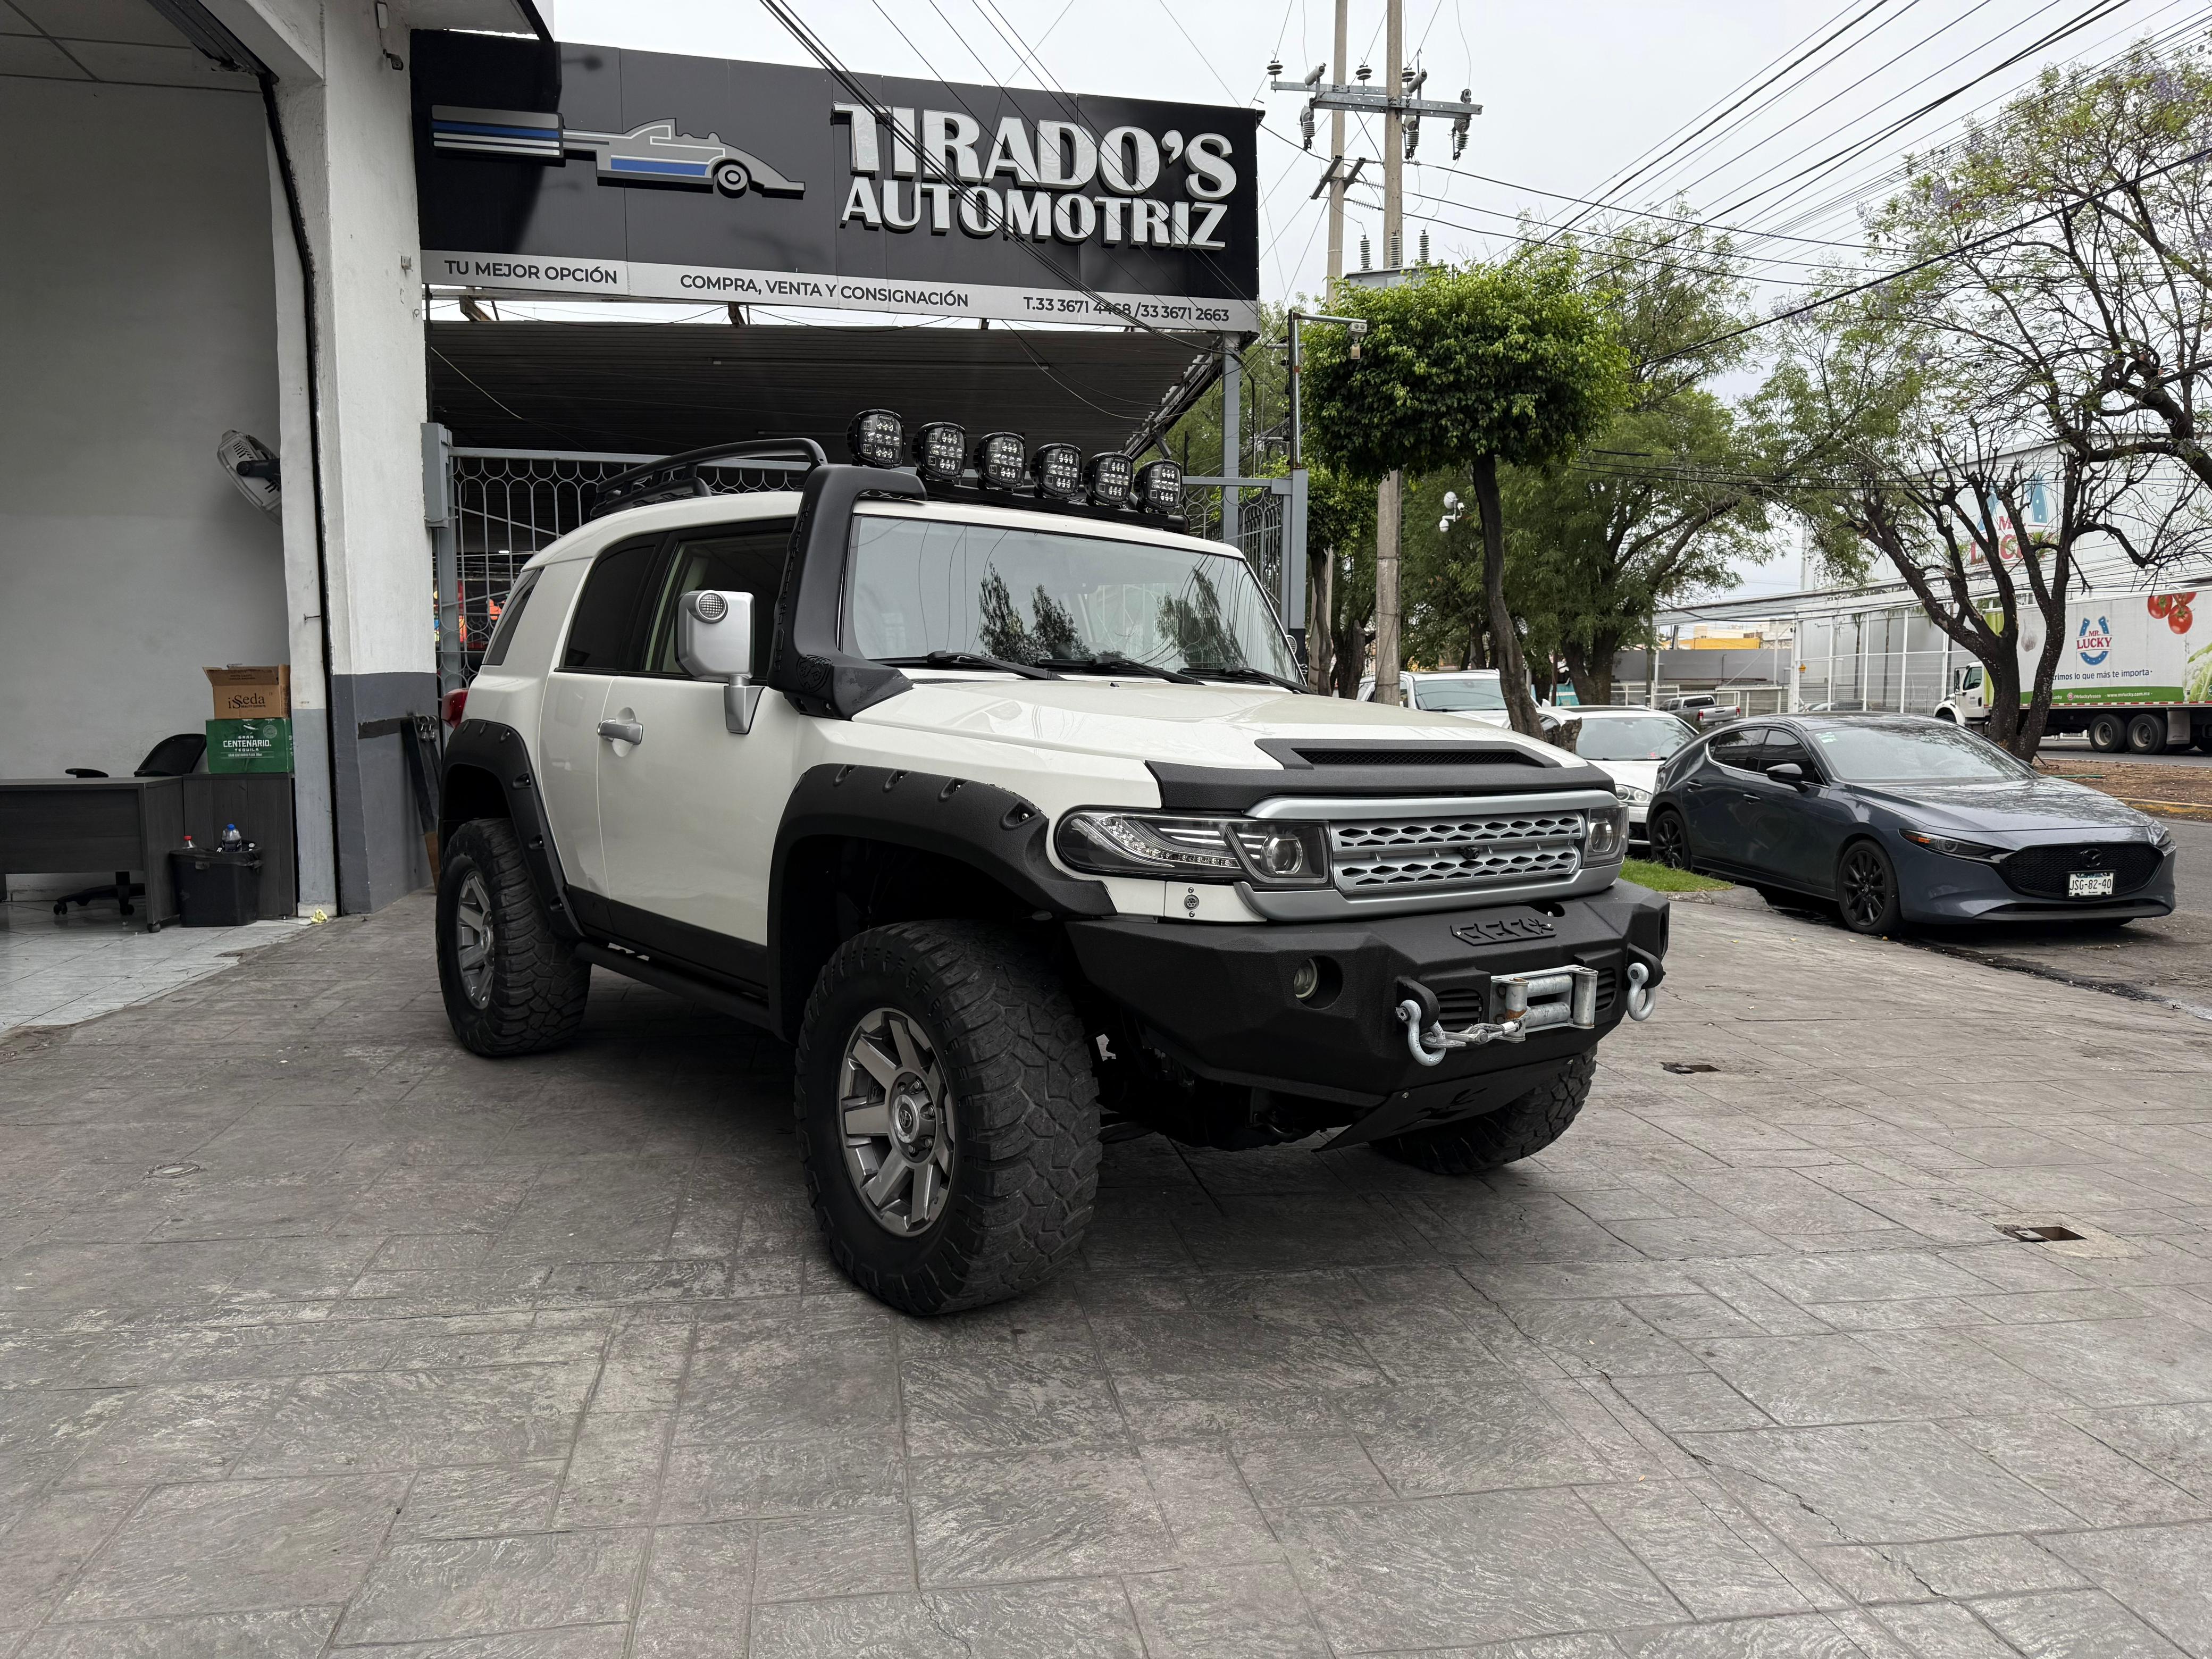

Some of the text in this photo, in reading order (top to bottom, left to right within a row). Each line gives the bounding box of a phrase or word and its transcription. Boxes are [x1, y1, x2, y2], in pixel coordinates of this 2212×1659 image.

[840, 177, 1228, 250] AUTOMOTRIZ
[445, 260, 617, 284] TU MEJOR OPCIÓN
[681, 274, 968, 307] COMPRA, VENTA Y CONSIGNACIÓN
[1023, 297, 1054, 311] T.33
[1058, 299, 1088, 313] 3671
[1134, 302, 1159, 318] /33
[1161, 306, 1192, 320] 3671
[1196, 308, 1229, 322] 2663
[2076, 638, 2112, 649] LUCKY
[2069, 879, 2112, 890] JSG-82-40
